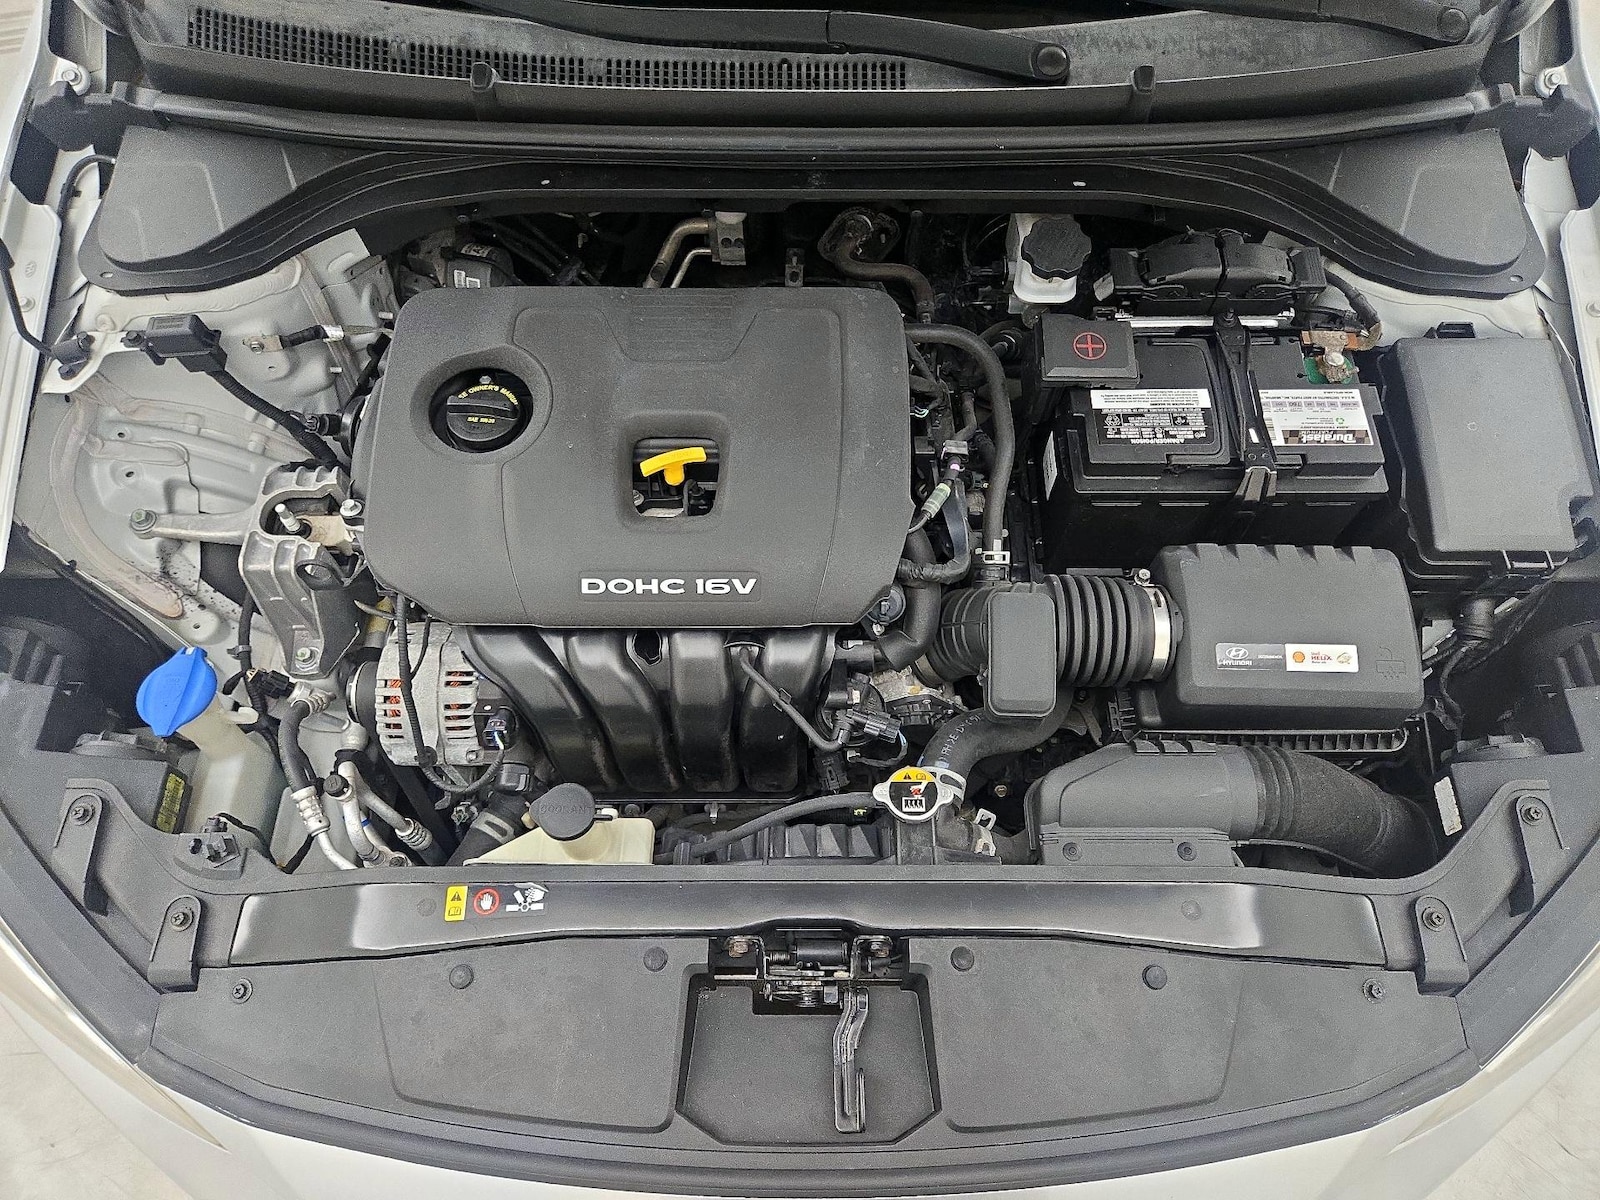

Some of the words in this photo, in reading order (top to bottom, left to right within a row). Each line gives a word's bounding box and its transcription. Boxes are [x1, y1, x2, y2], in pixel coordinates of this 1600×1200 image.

[468, 384, 499, 393] OWNER'S
[1300, 433, 1357, 444] Duralast
[581, 578, 686, 595] DOHC
[695, 578, 758, 595] 16V
